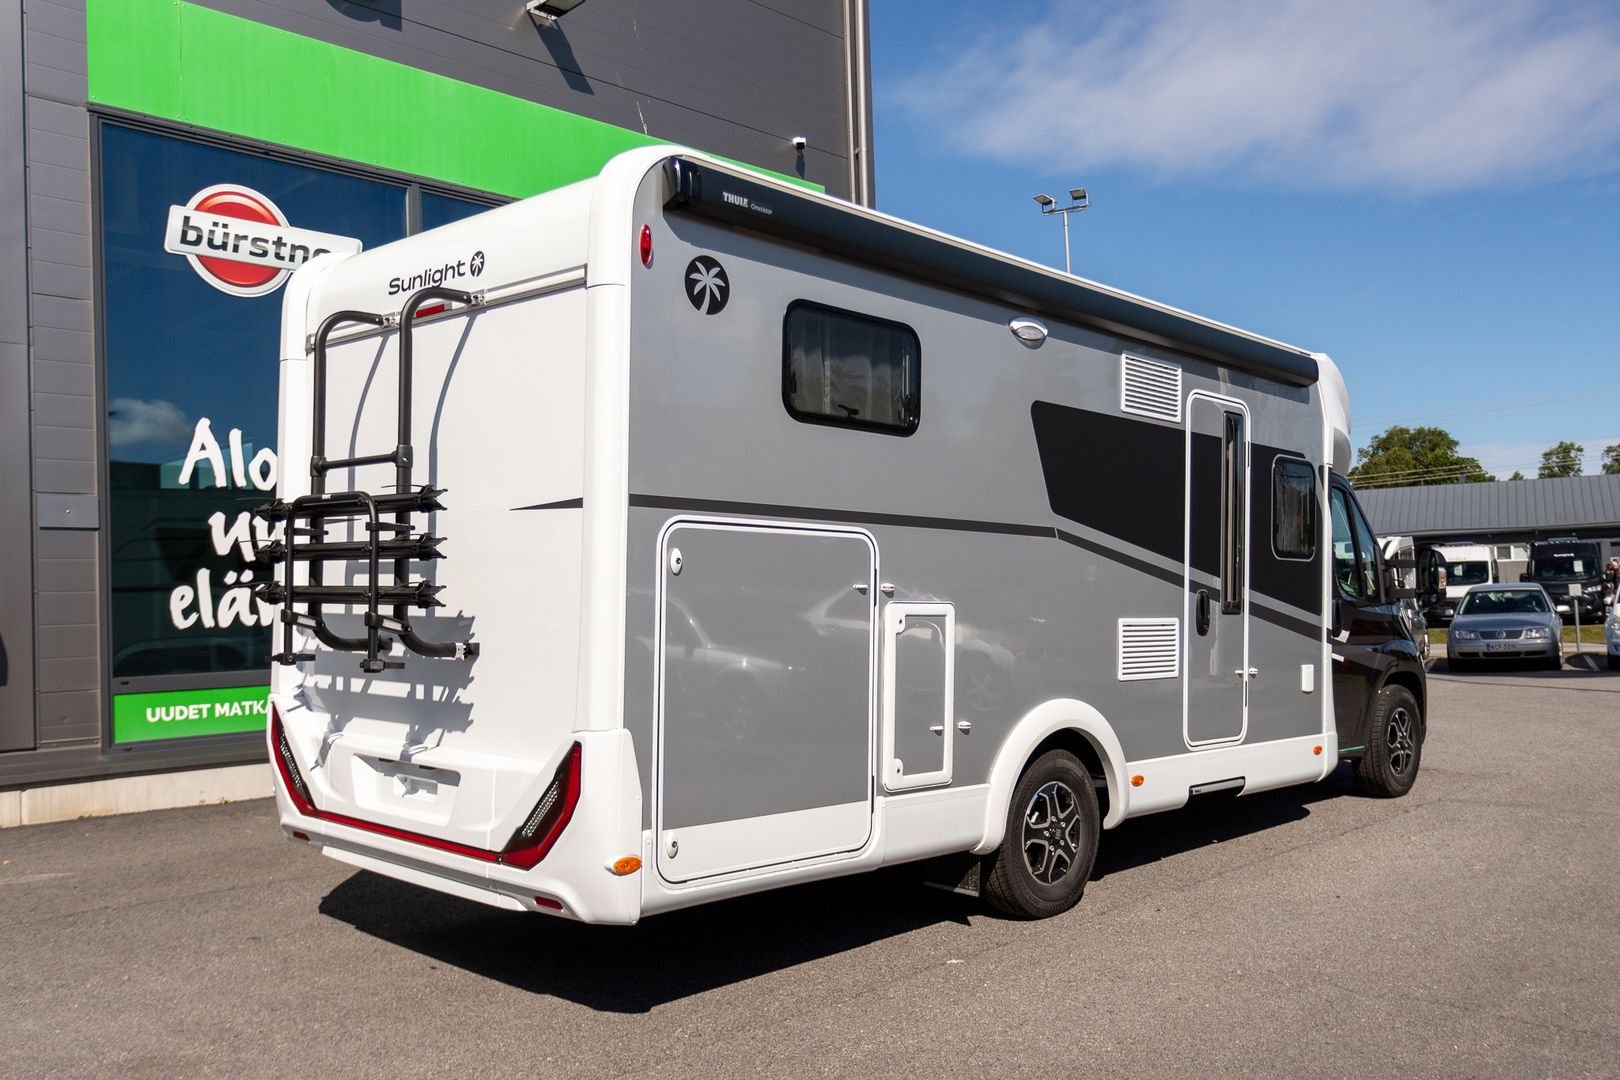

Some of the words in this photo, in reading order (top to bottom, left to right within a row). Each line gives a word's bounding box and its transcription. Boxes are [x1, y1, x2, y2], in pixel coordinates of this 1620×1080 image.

[722, 191, 749, 208] THULE
[388, 260, 466, 295] Sunlight
[178, 417, 278, 491] Alo
[169, 567, 275, 630] elä
[146, 703, 211, 723] UUDET
